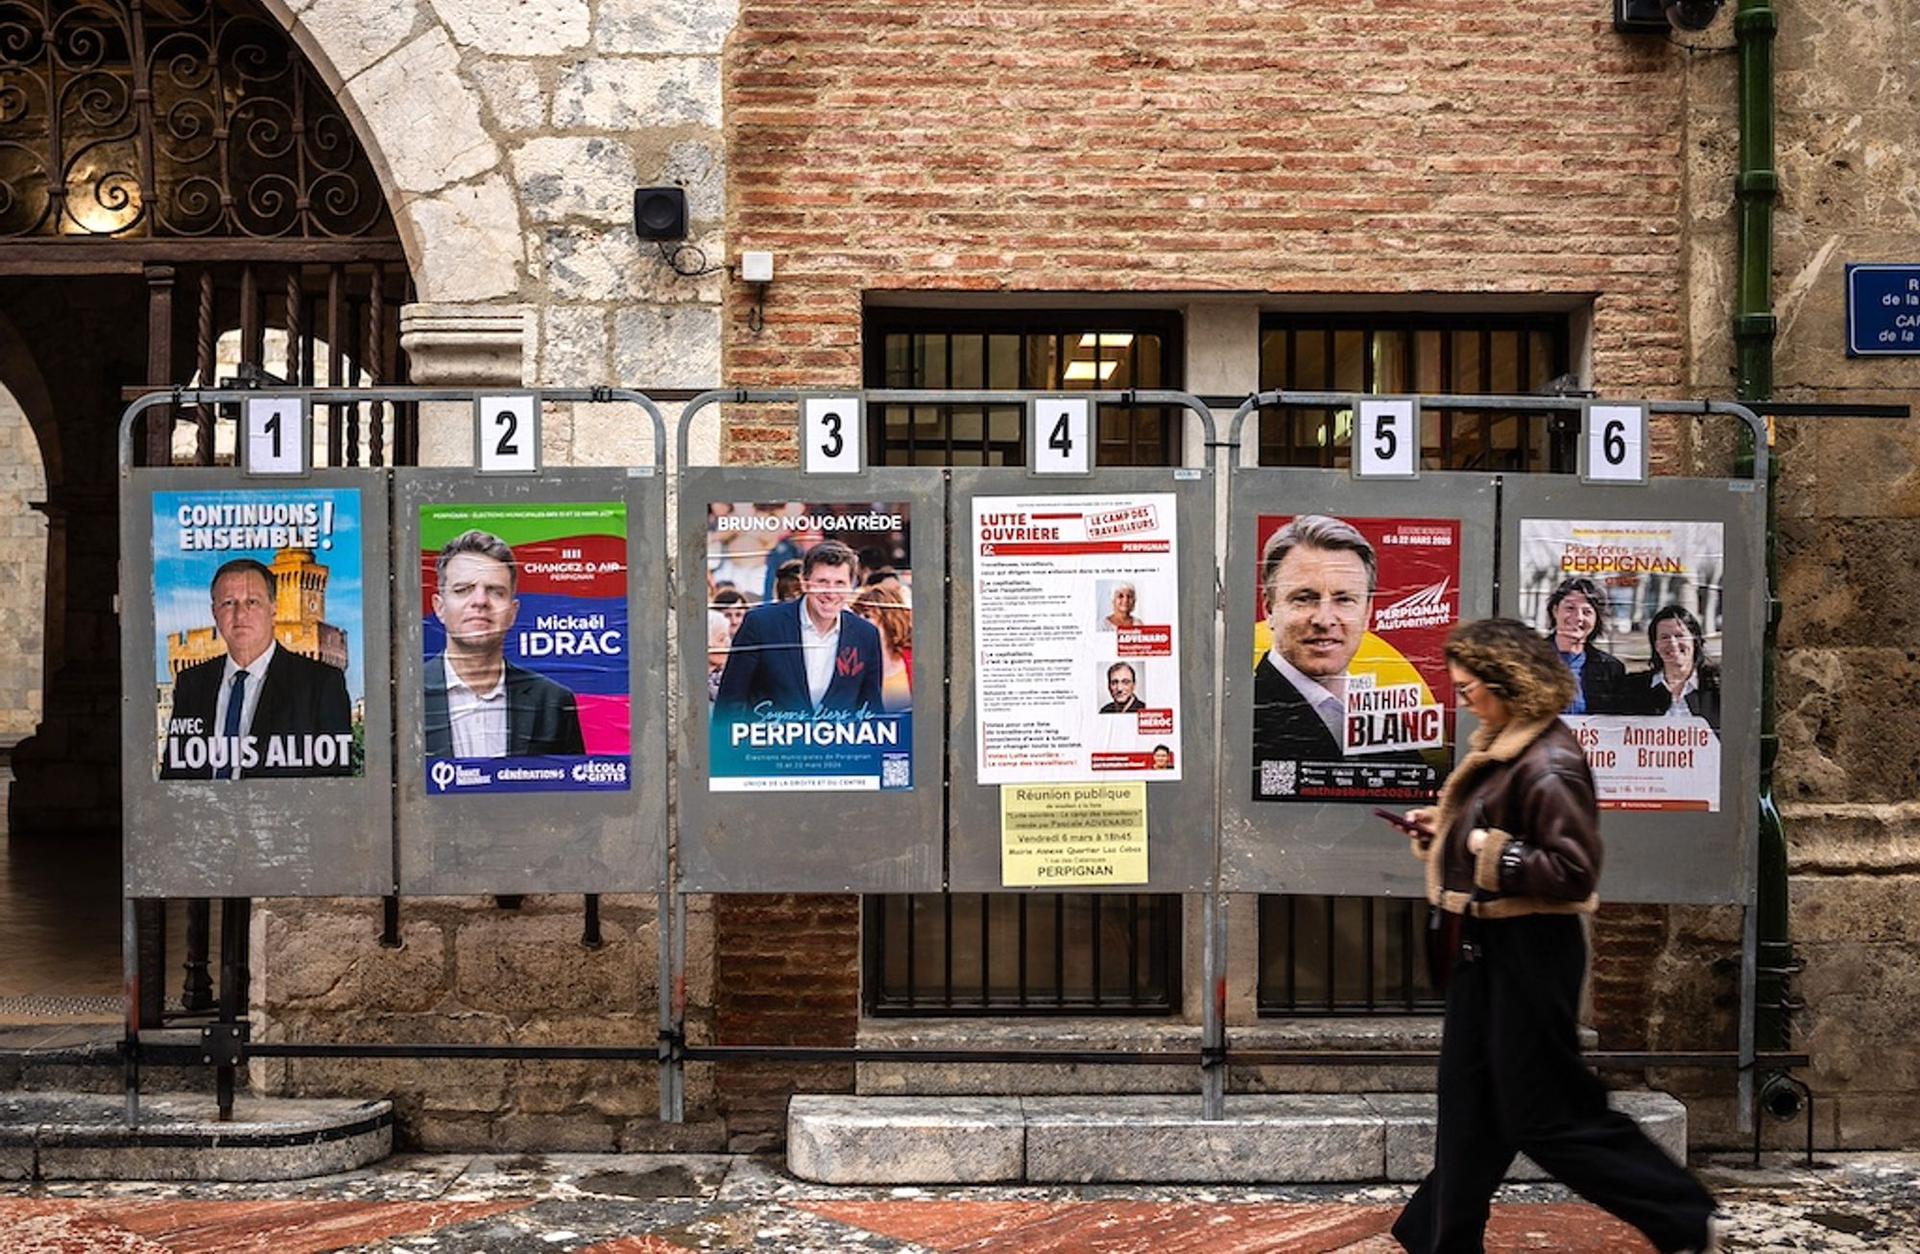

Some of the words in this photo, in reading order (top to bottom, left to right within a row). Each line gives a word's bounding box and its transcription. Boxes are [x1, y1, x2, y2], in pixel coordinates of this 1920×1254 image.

[1882, 293, 1901, 306] de
[1905, 293, 1919, 306] la
[1878, 330, 1897, 342] de
[1901, 330, 1914, 342] la
[264, 412, 282, 458] 1
[495, 411, 519, 455] 2
[821, 412, 843, 457] 3
[1048, 412, 1073, 457] 4
[1374, 415, 1397, 459] 5
[1603, 420, 1626, 465] 6
[178, 503, 318, 527] CONTINUONS
[717, 516, 780, 531] BRUNO
[783, 511, 902, 531] NOUGAYRÈDE
[981, 513, 1027, 526] LUTTE
[1091, 516, 1102, 526] LE
[1103, 512, 1130, 524] CAMP
[1131, 508, 1150, 519] DES
[981, 524, 1060, 541] OUVRIÈRE
[1089, 518, 1155, 537] TRAVAILLEURS
[1122, 543, 1170, 552] PERPIGNAN
[1410, 535, 1431, 545] MARS
[524, 562, 583, 573] CHANGEZ
[1561, 556, 1682, 573] PERPIGNAN
[1376, 602, 1450, 620] PERPIGNAN
[536, 614, 605, 630] Mickaël
[1376, 613, 1450, 631] Autrement
[519, 630, 621, 656] IDRAC
[1349, 687, 1419, 712] MATHIAS
[170, 718, 203, 734] AVEC
[731, 721, 897, 746] PERPIGNAN
[1348, 709, 1439, 747] BLANC
[1624, 727, 1708, 746] Annabelle
[169, 736, 259, 768] LOUIS
[265, 734, 353, 767] ALIOT
[1637, 748, 1694, 768] Brunet
[1016, 788, 1071, 801] Réunion
[1074, 788, 1131, 802] publique
[1017, 834, 1060, 843] Vendredi
[1070, 834, 1093, 842] mars
[1037, 865, 1114, 878] PERPIGNAN
